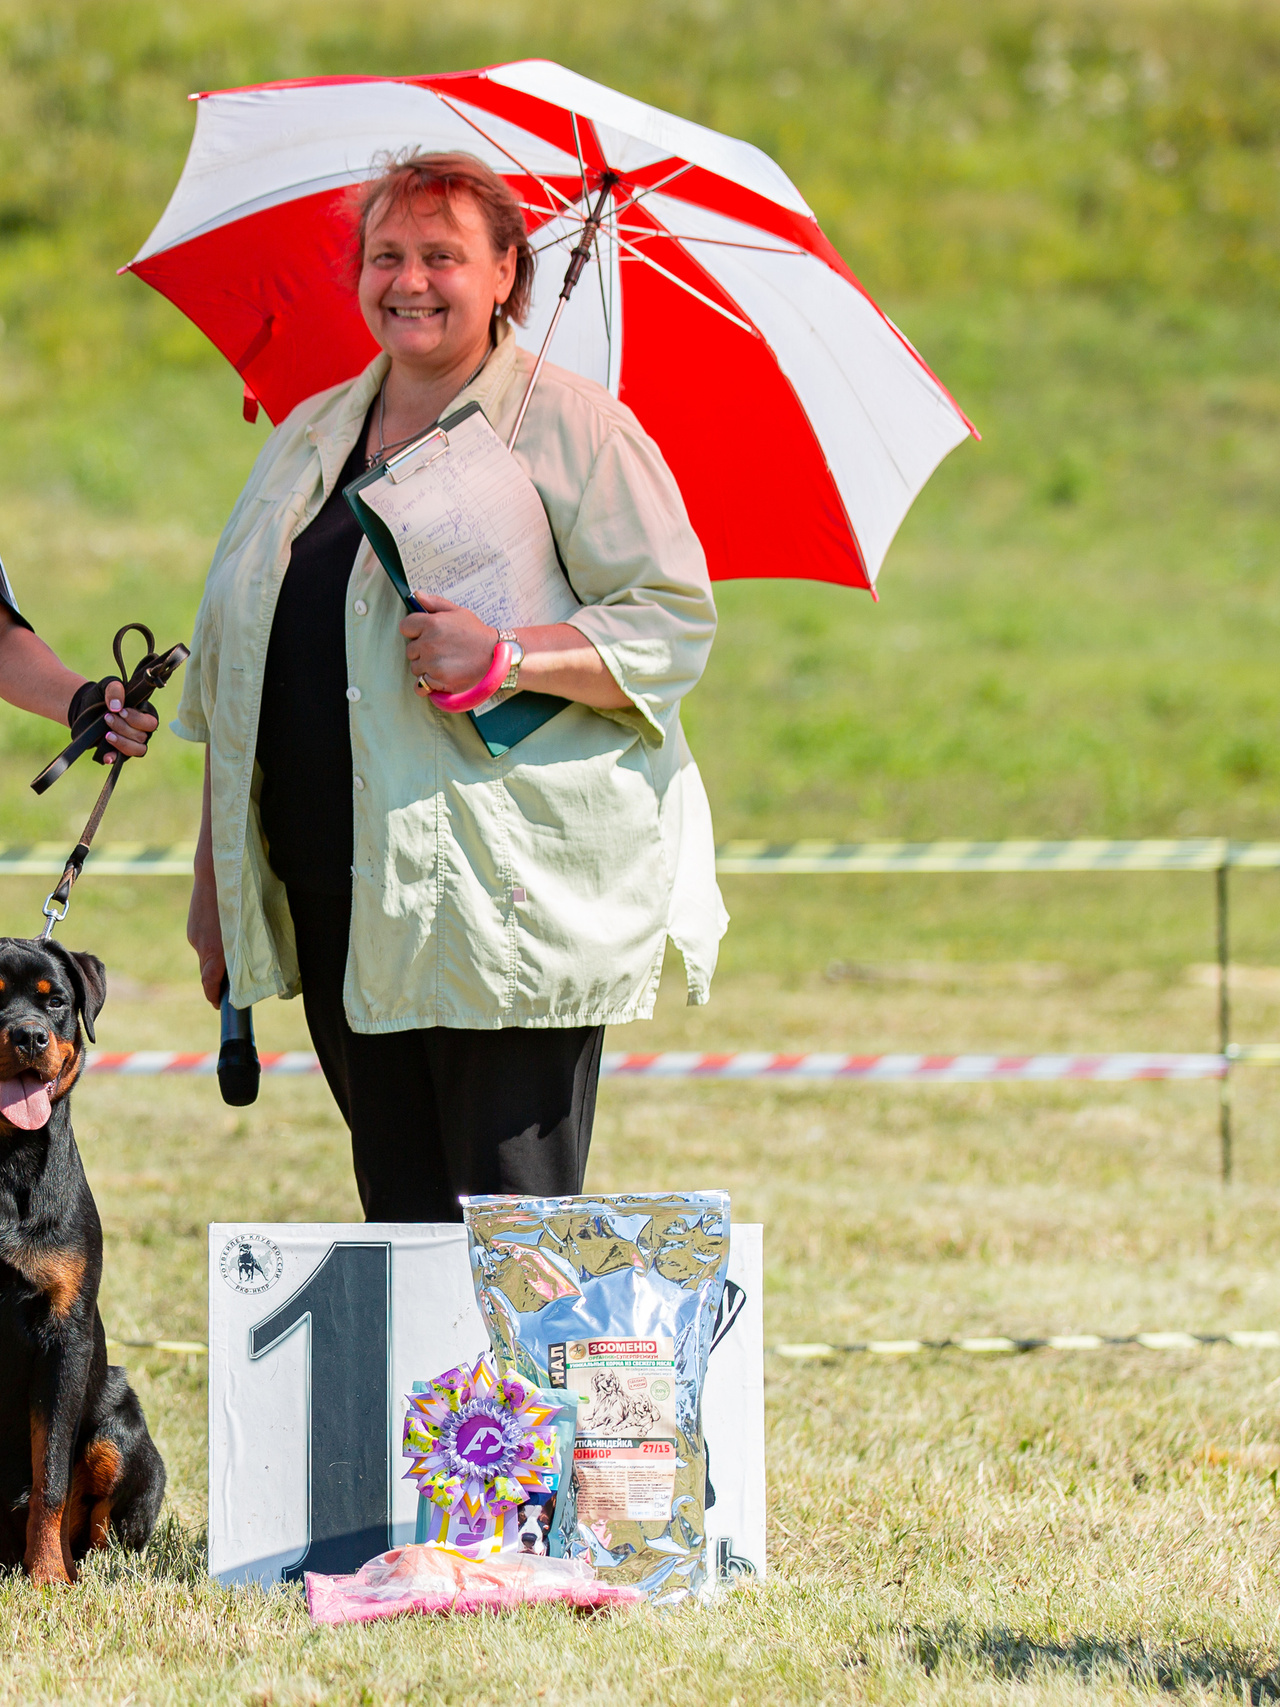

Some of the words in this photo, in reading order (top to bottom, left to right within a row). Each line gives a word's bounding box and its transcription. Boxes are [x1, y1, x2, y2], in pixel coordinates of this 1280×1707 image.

[590, 1342, 656, 1354] ЗООМЕНЮ
[249, 1241, 393, 1583] 1
[574, 1450, 612, 1459] ЮНИОР
[643, 1444, 670, 1454] 27/15
